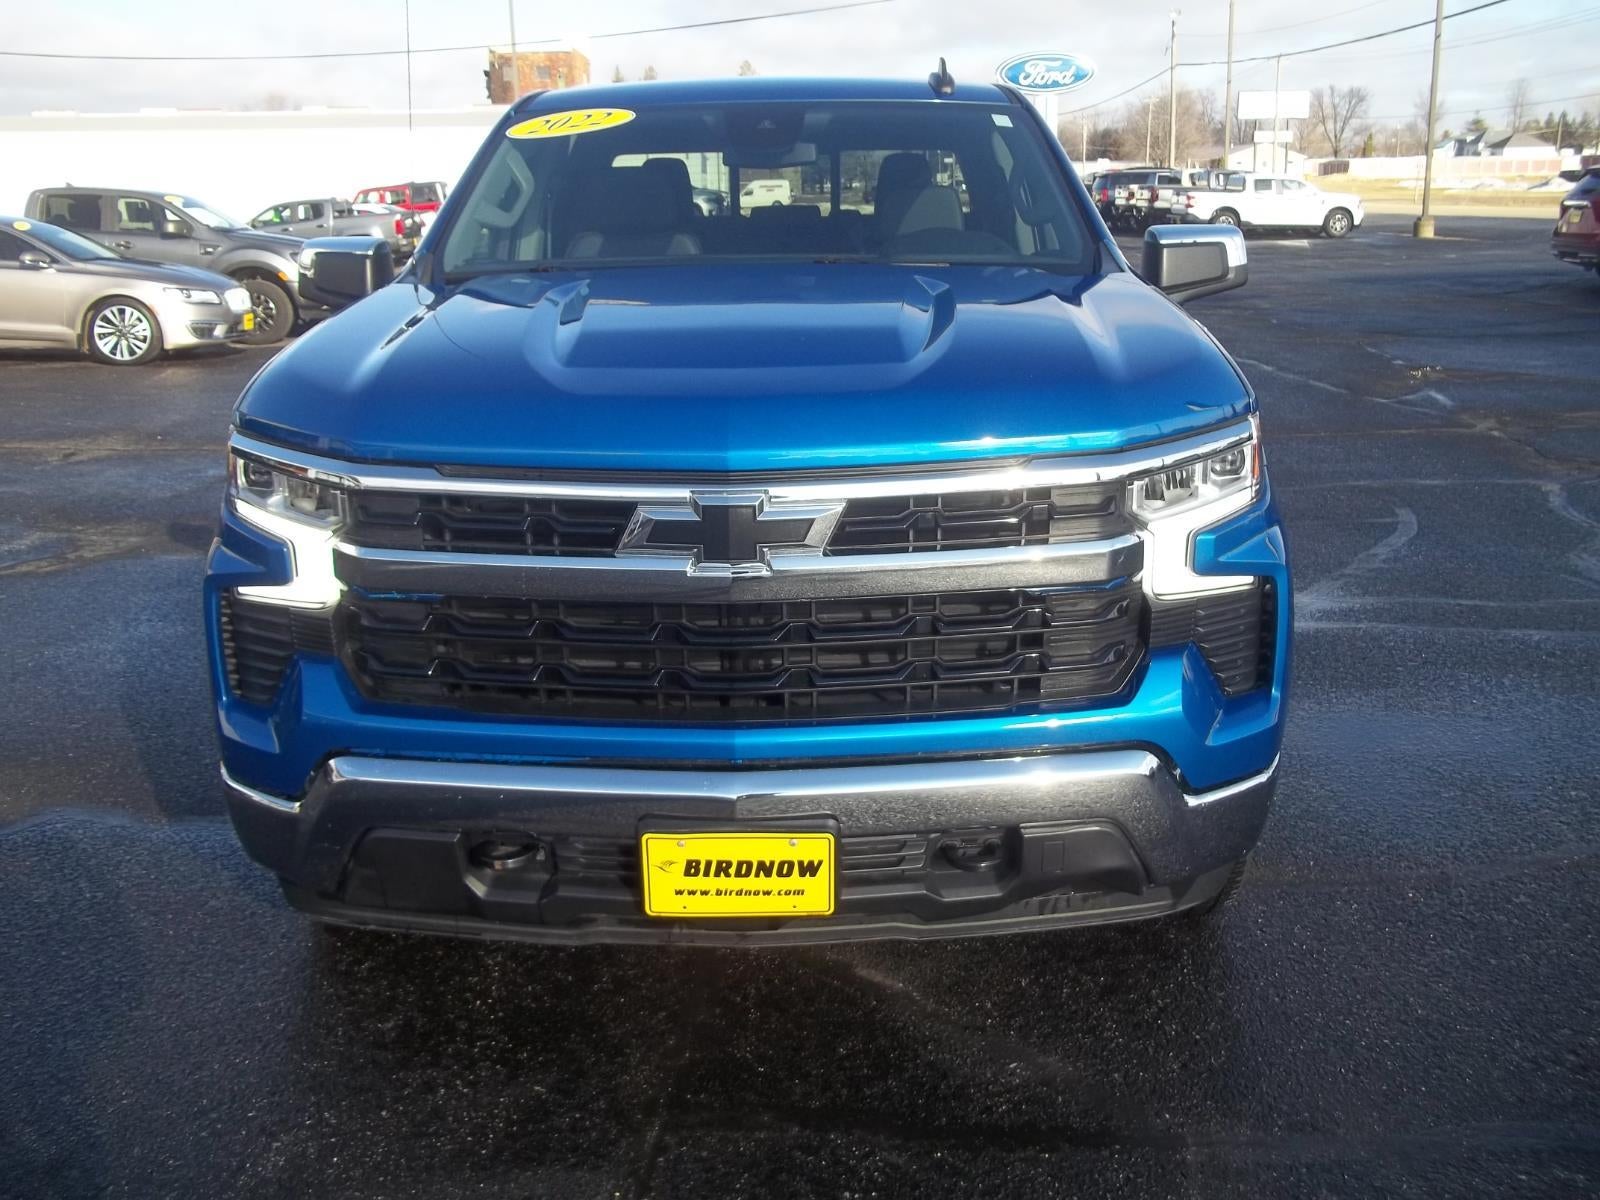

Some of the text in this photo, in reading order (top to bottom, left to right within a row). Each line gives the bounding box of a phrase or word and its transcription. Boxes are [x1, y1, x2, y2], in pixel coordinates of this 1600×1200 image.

[1019, 60, 1077, 85] Ford
[525, 111, 613, 134] 2022
[683, 858, 824, 878] BIRDNOW
[674, 888, 805, 897] www.birdnow.com
